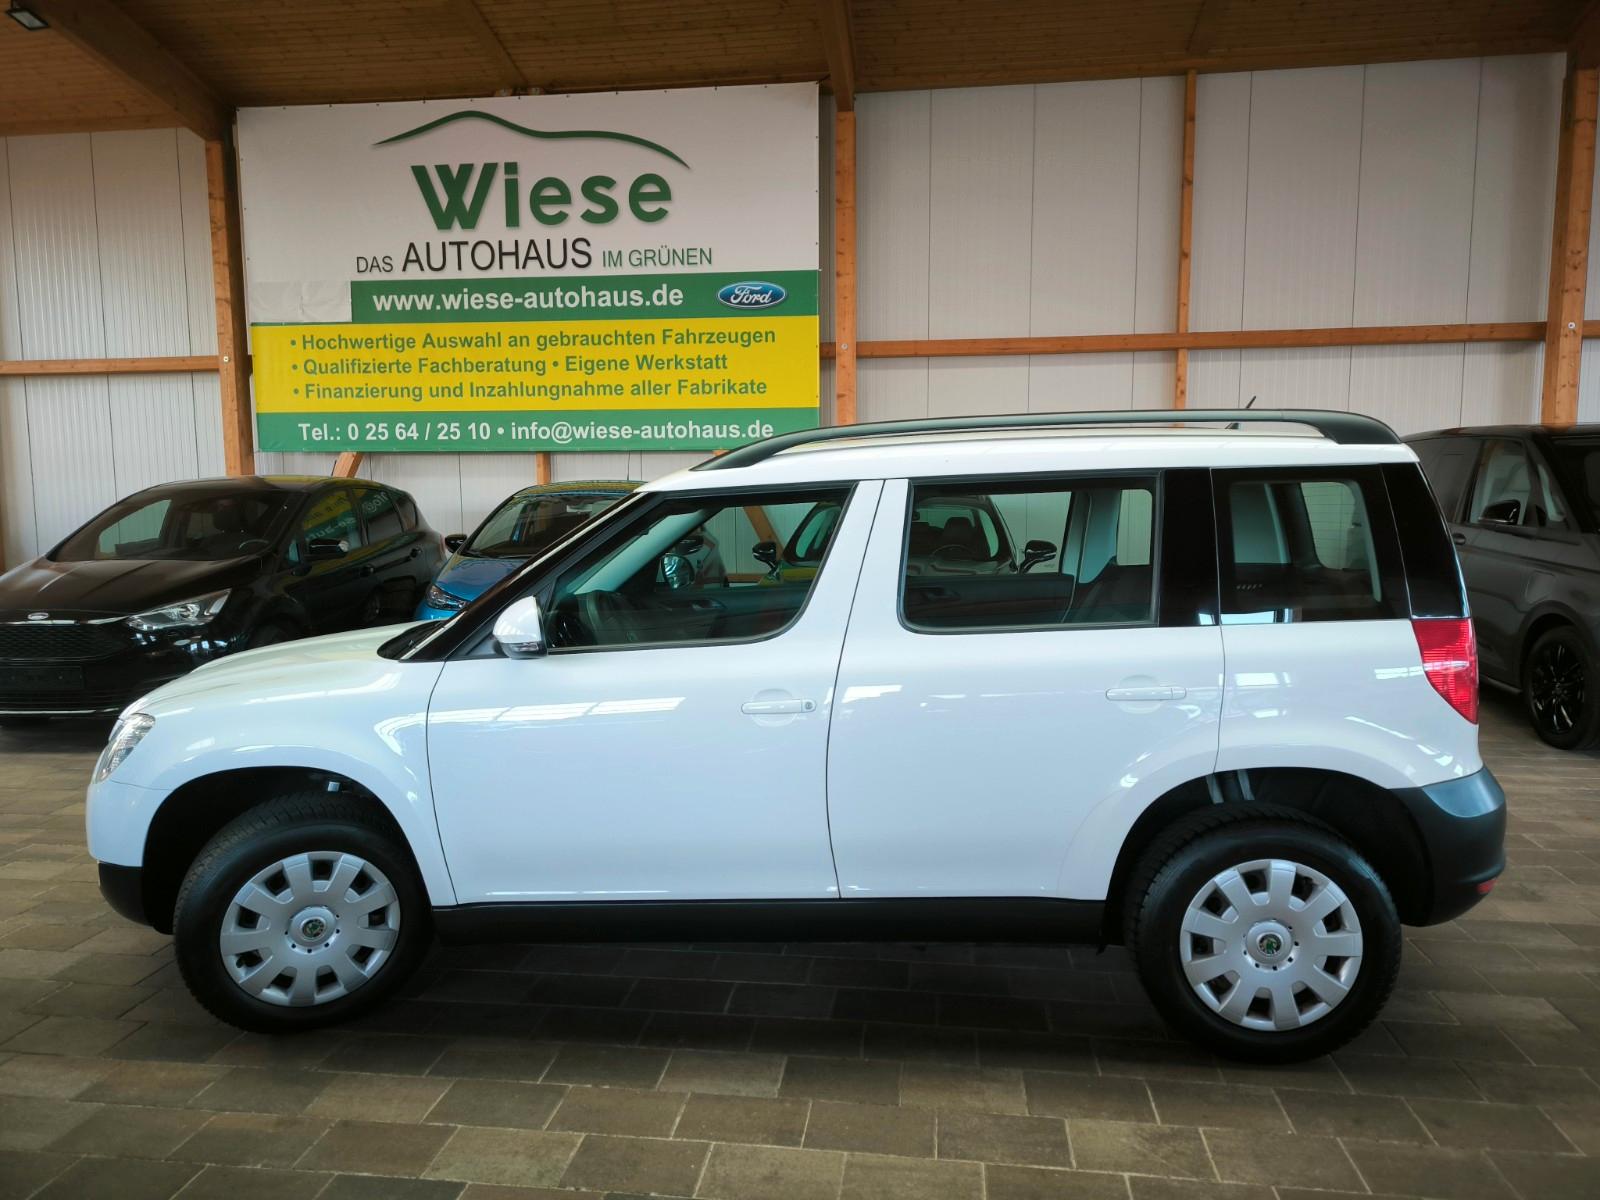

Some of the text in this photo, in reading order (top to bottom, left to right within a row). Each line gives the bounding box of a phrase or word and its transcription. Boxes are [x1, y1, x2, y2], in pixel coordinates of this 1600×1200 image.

[410, 161, 672, 231] Wiese
[355, 237, 713, 273] DAS AUTOHAUS IM GRÜNEN
[372, 283, 684, 312] www.wiese-autohaus.de
[302, 328, 776, 353] Hochwertige Auswahl an gebrauchten Fahrzeugen
[303, 353, 728, 376] Qualifizierte Fachberatung Eigene Werkstatt
[304, 378, 767, 402] Finanzierung und Inzahlungnahme aller Fabrikate
[298, 420, 774, 444] Tel.: 0 25 64 / 25 10 info@wiese-autohaus.de
